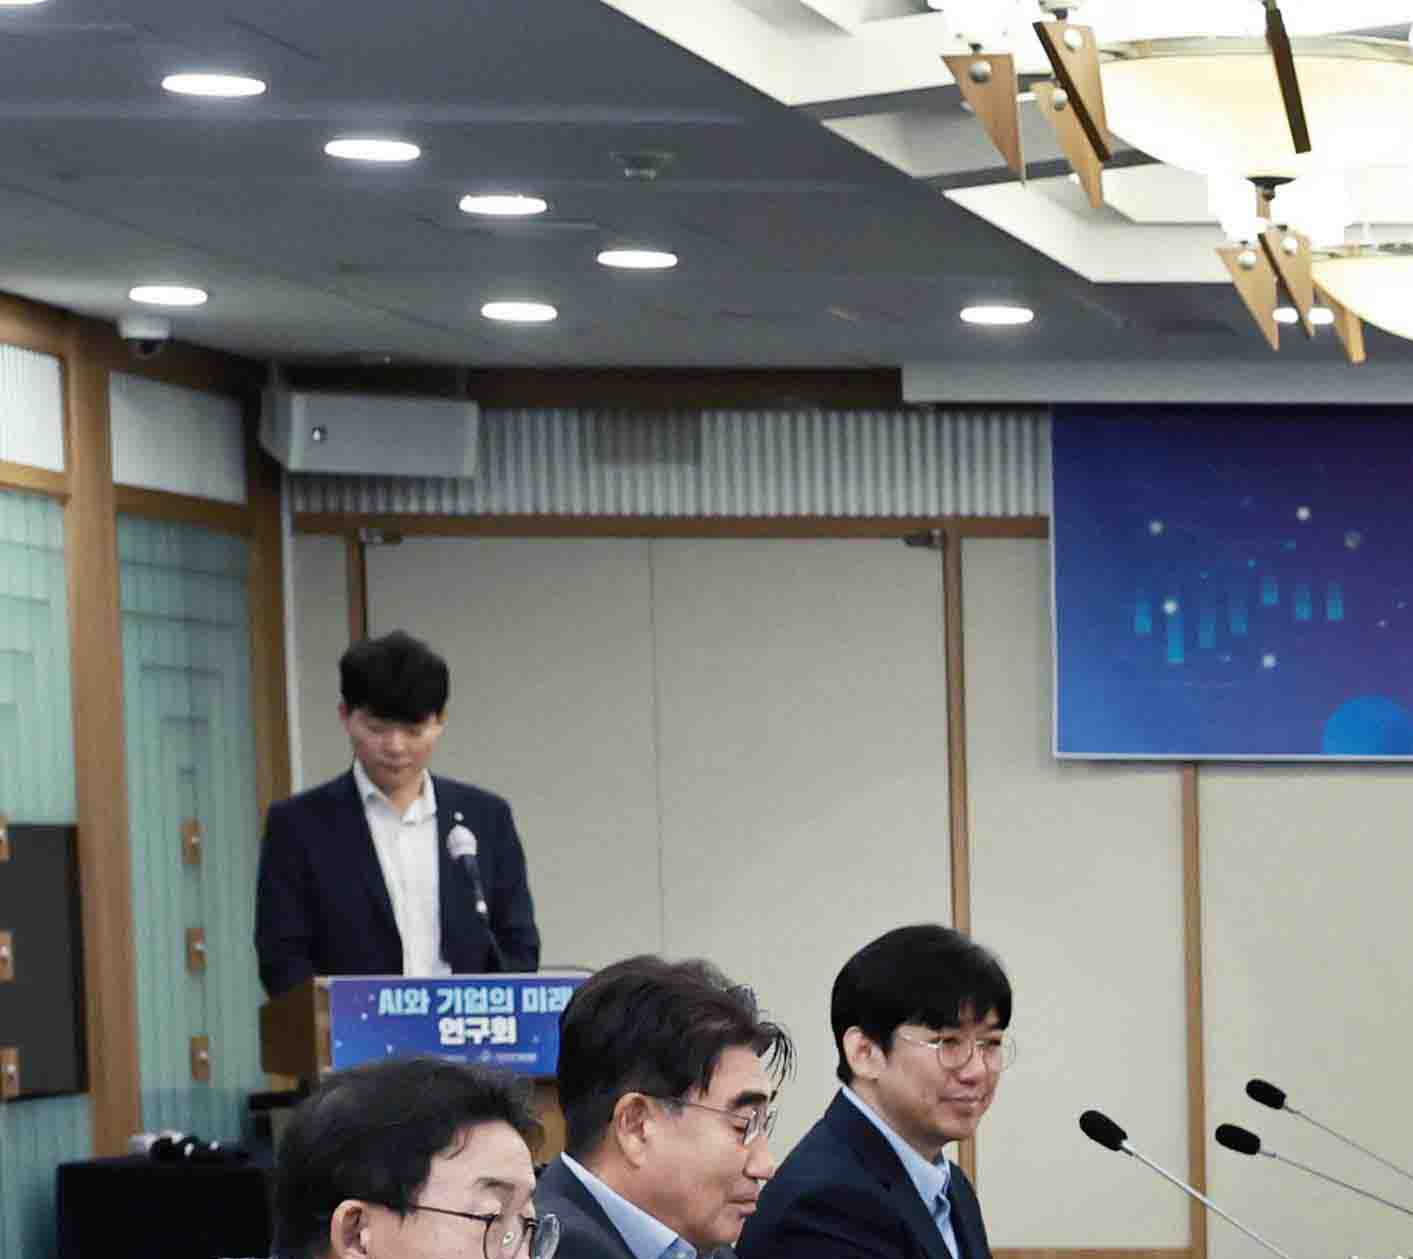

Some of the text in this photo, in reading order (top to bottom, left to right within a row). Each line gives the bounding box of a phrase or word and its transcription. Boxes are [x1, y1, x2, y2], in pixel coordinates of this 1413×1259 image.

[379, 988, 431, 1016] AI와
[437, 986, 514, 1016] 기업의
[438, 1016, 517, 1045] 연구회
